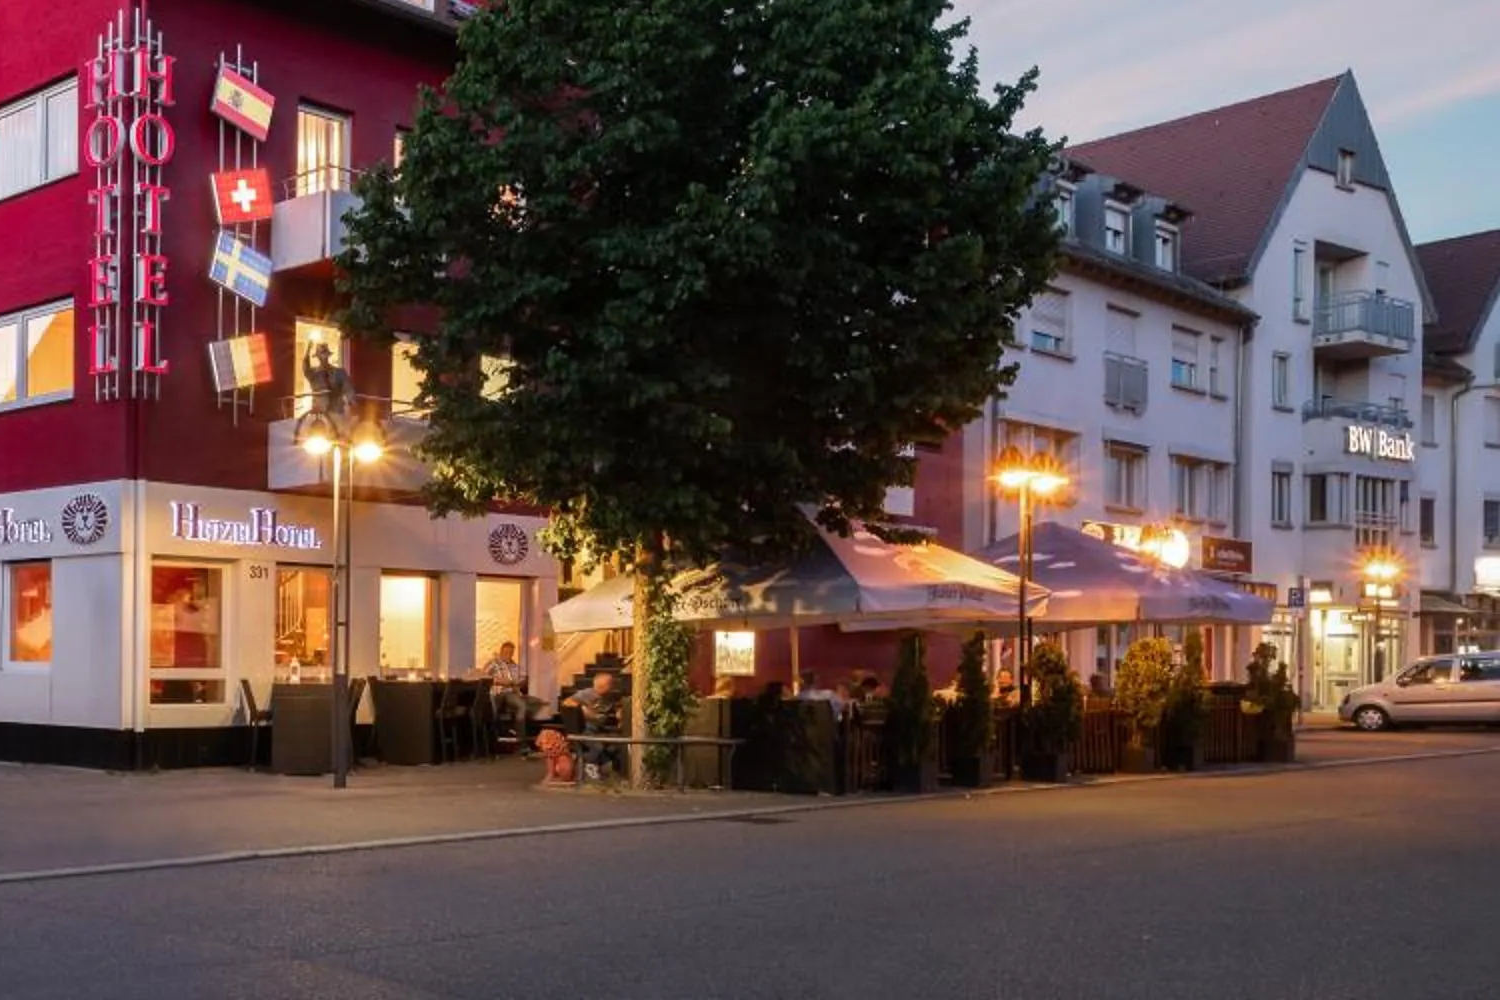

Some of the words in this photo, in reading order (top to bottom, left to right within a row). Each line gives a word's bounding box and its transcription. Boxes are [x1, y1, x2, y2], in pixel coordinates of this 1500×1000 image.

[84, 48, 125, 374] HOTEL
[130, 47, 176, 375] HOTEL
[1379, 431, 1415, 461] Bank
[249, 564, 269, 580] 331
